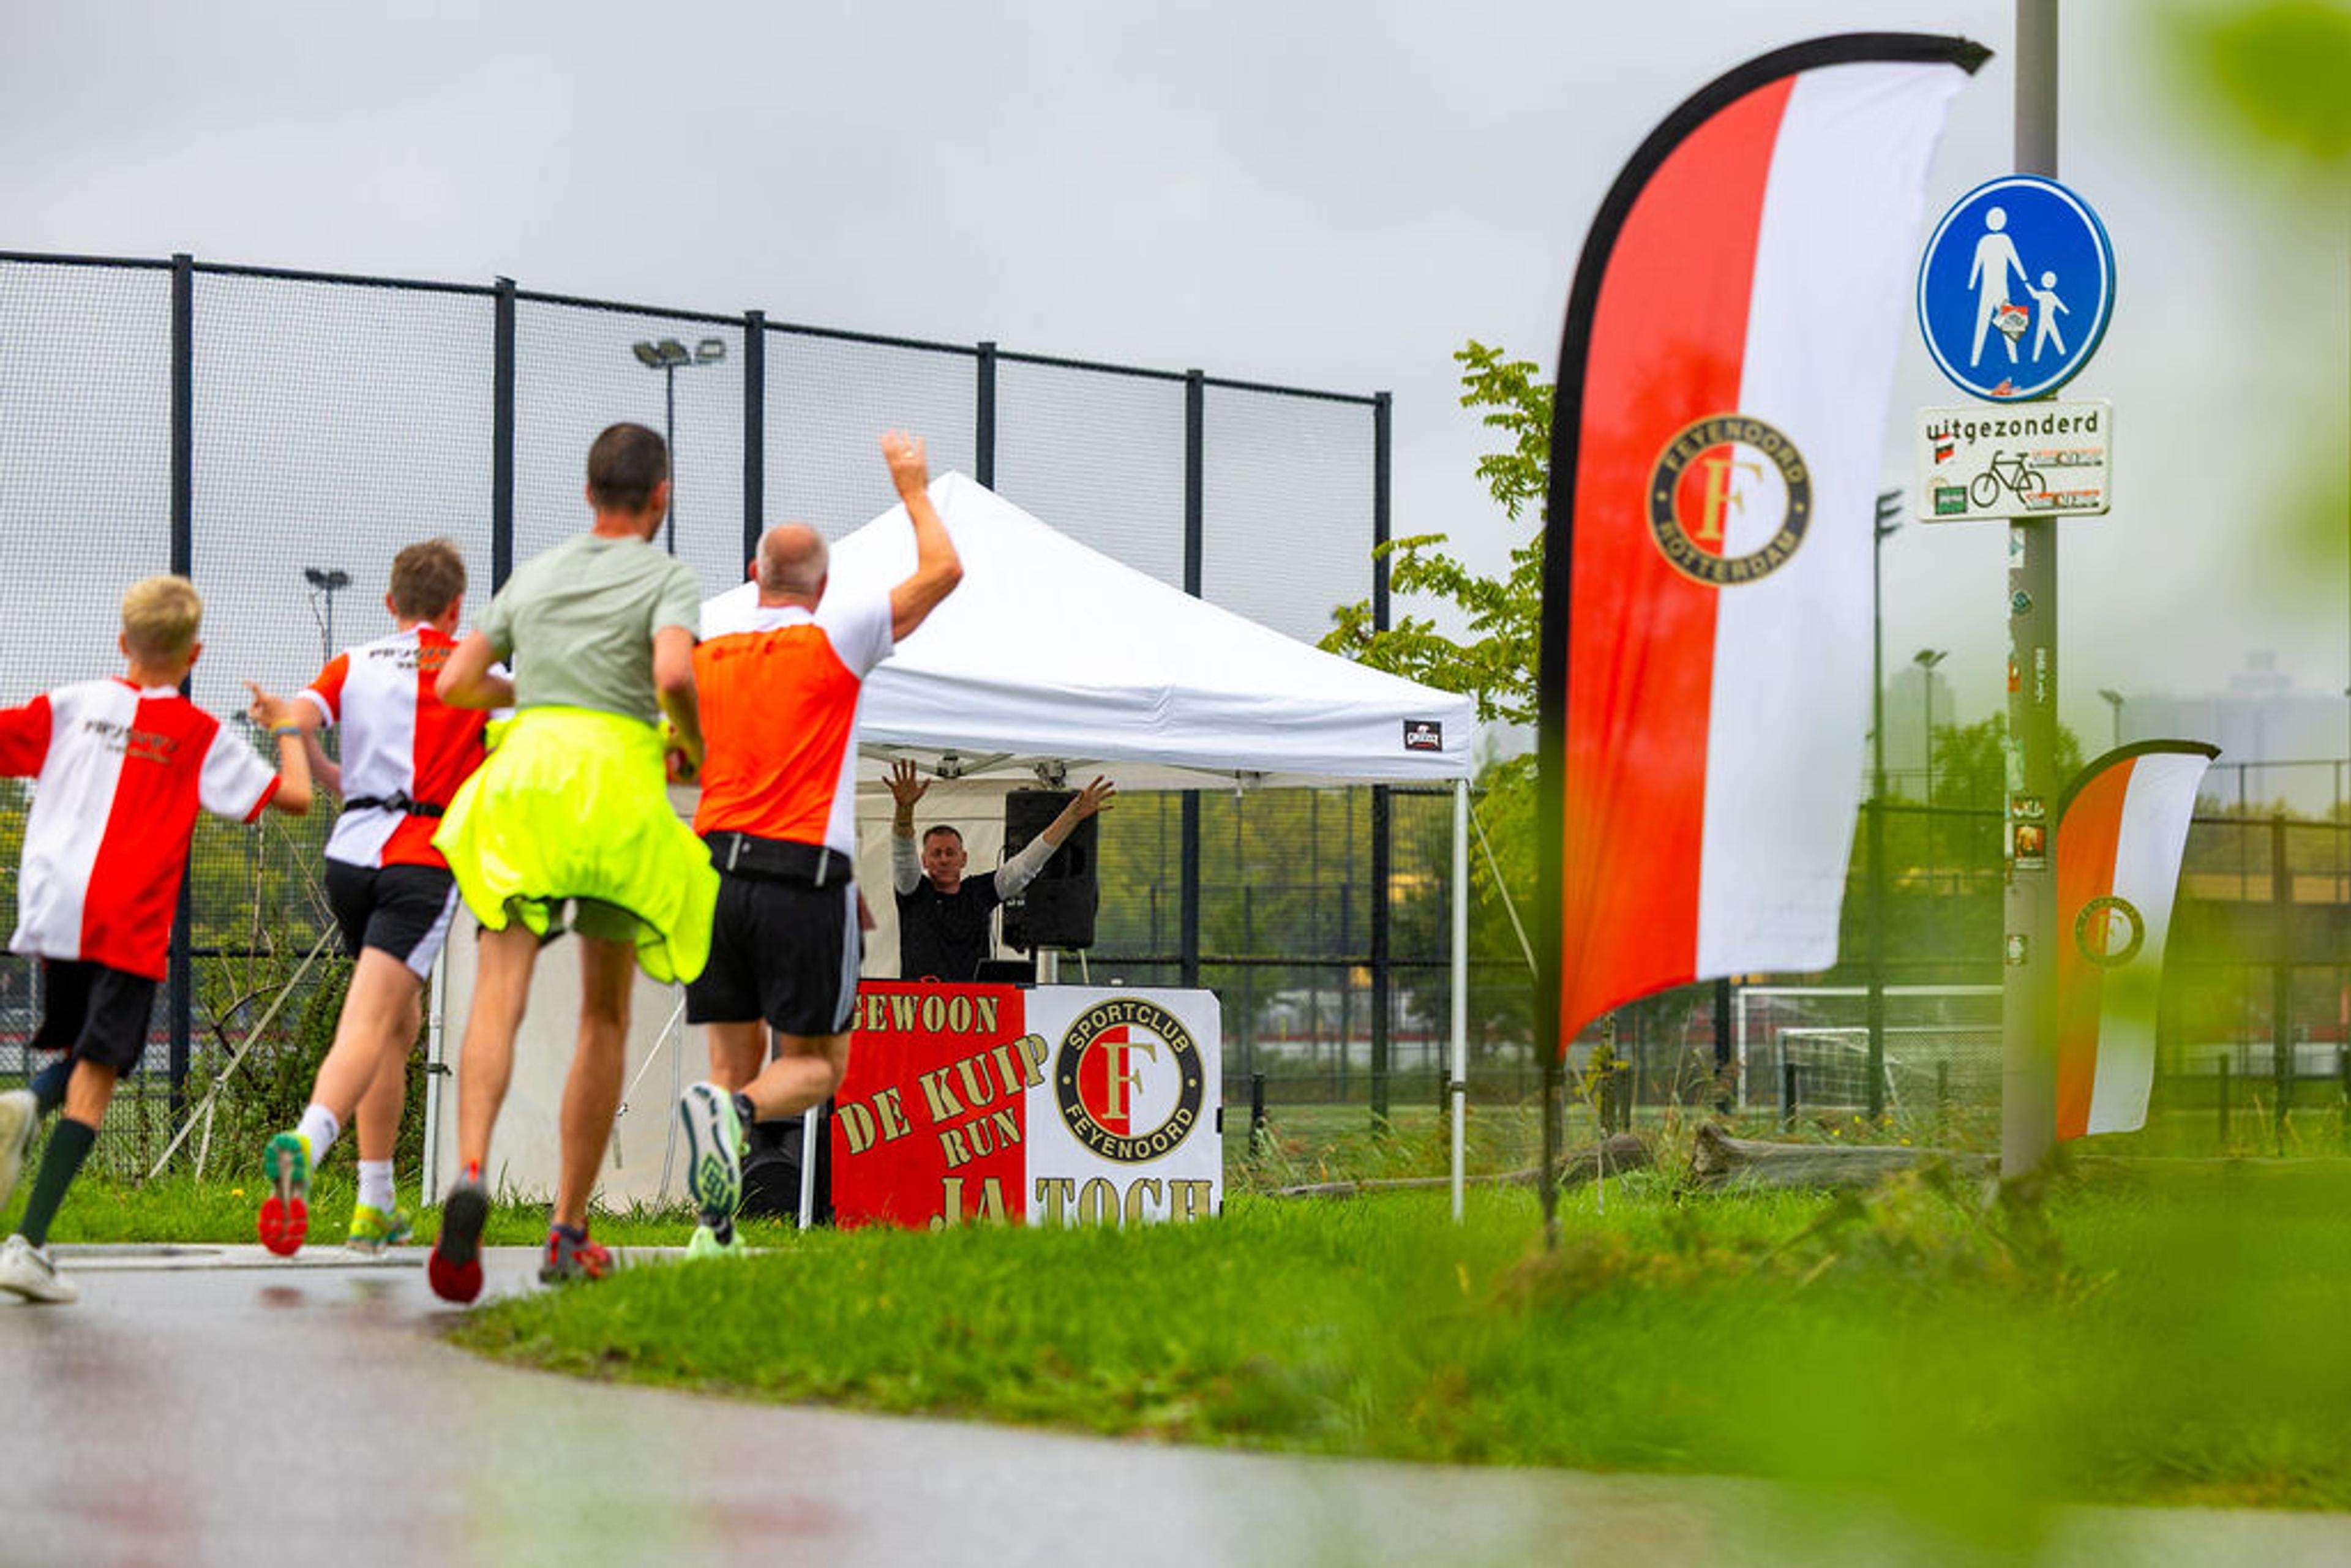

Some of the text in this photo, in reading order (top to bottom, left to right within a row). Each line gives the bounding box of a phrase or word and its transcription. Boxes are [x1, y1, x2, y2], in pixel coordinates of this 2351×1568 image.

[1665, 420, 1805, 485] FEYENOORD
[1927, 411, 2098, 445] uitgezonderd
[1696, 458, 1763, 540] F
[1659, 520, 1798, 582] ROTTERDAM
[1069, 1002, 1190, 1053] SPORTCLUB
[836, 1033, 1049, 1155] DE KUIP
[1100, 1042, 1157, 1120] F
[937, 1106, 1022, 1169] RUN
[1065, 1103, 1193, 1159] FEYENOORD
[928, 1177, 1213, 1231] JA TOCH
